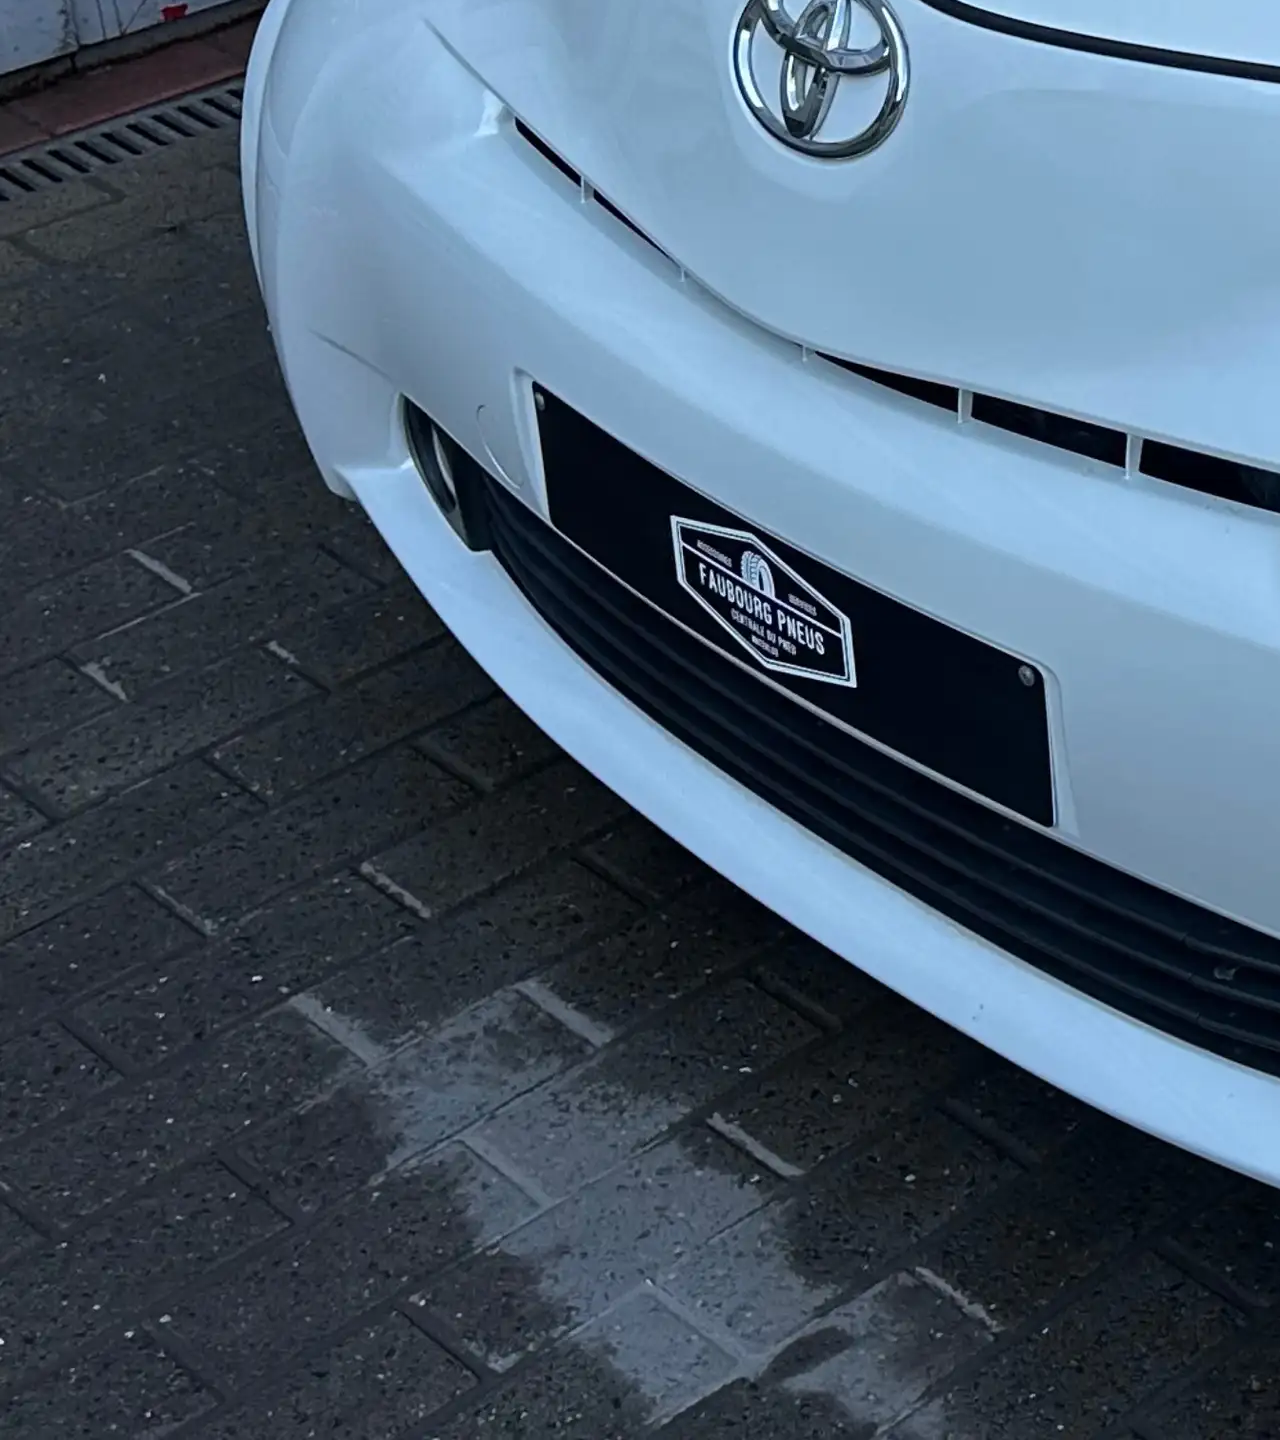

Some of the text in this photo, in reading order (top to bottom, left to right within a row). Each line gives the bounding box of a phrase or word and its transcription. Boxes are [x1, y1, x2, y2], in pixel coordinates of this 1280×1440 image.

[698, 561, 773, 625] FAUBOURG
[776, 608, 825, 656] PNEUS
[730, 608, 766, 638] CENTRALE
[766, 628, 777, 644] DU
